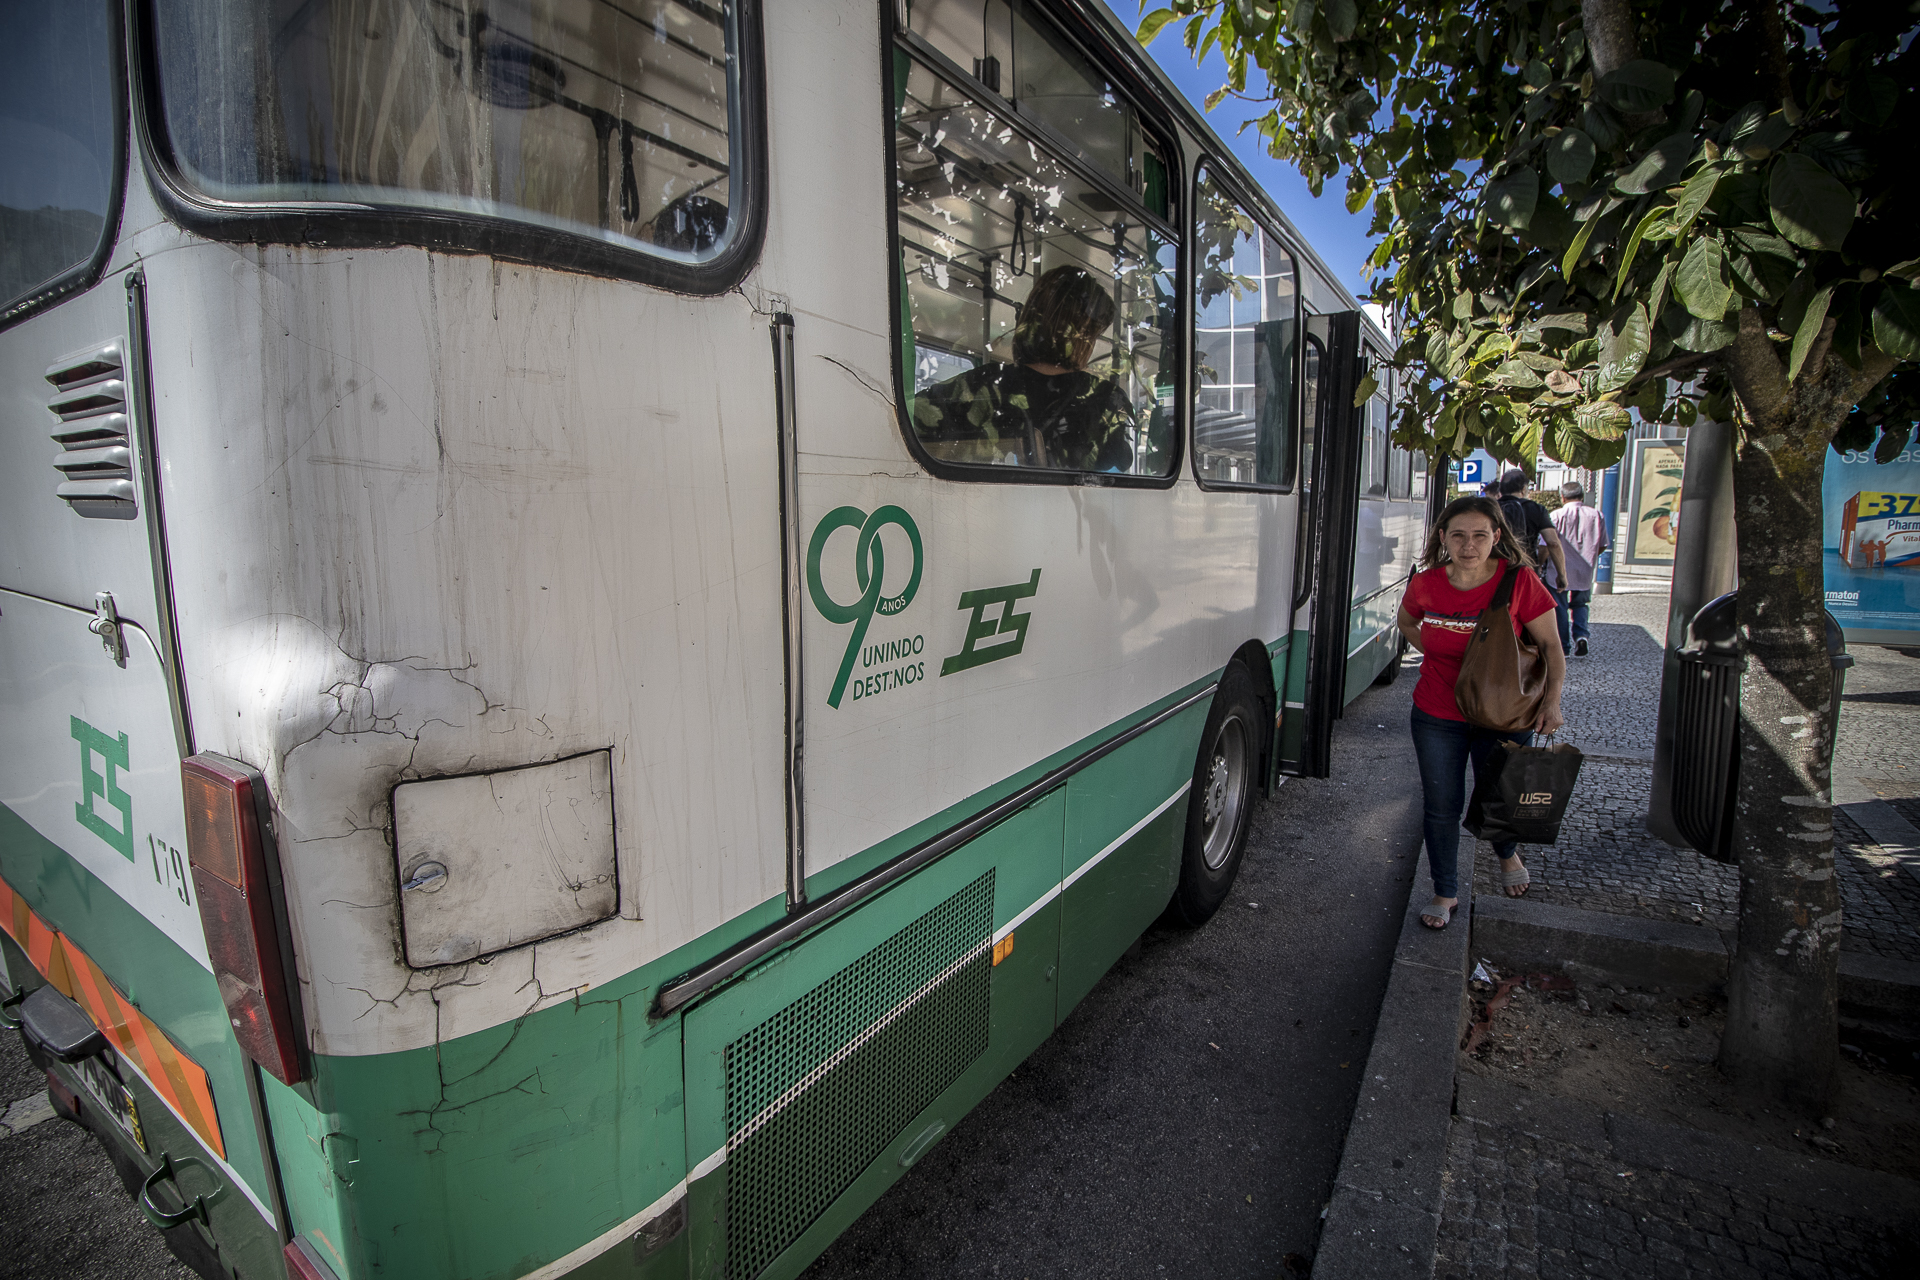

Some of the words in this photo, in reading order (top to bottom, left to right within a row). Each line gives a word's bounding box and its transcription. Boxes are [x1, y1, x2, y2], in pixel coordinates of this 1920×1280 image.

[1463, 462, 1478, 482] P
[1868, 495, 1920, 515] -37
[1887, 519, 1920, 531] Pharm
[806, 505, 924, 711] 90
[881, 595, 907, 613] ANOS
[863, 634, 925, 669] UNINDO
[149, 832, 191, 907] 179
